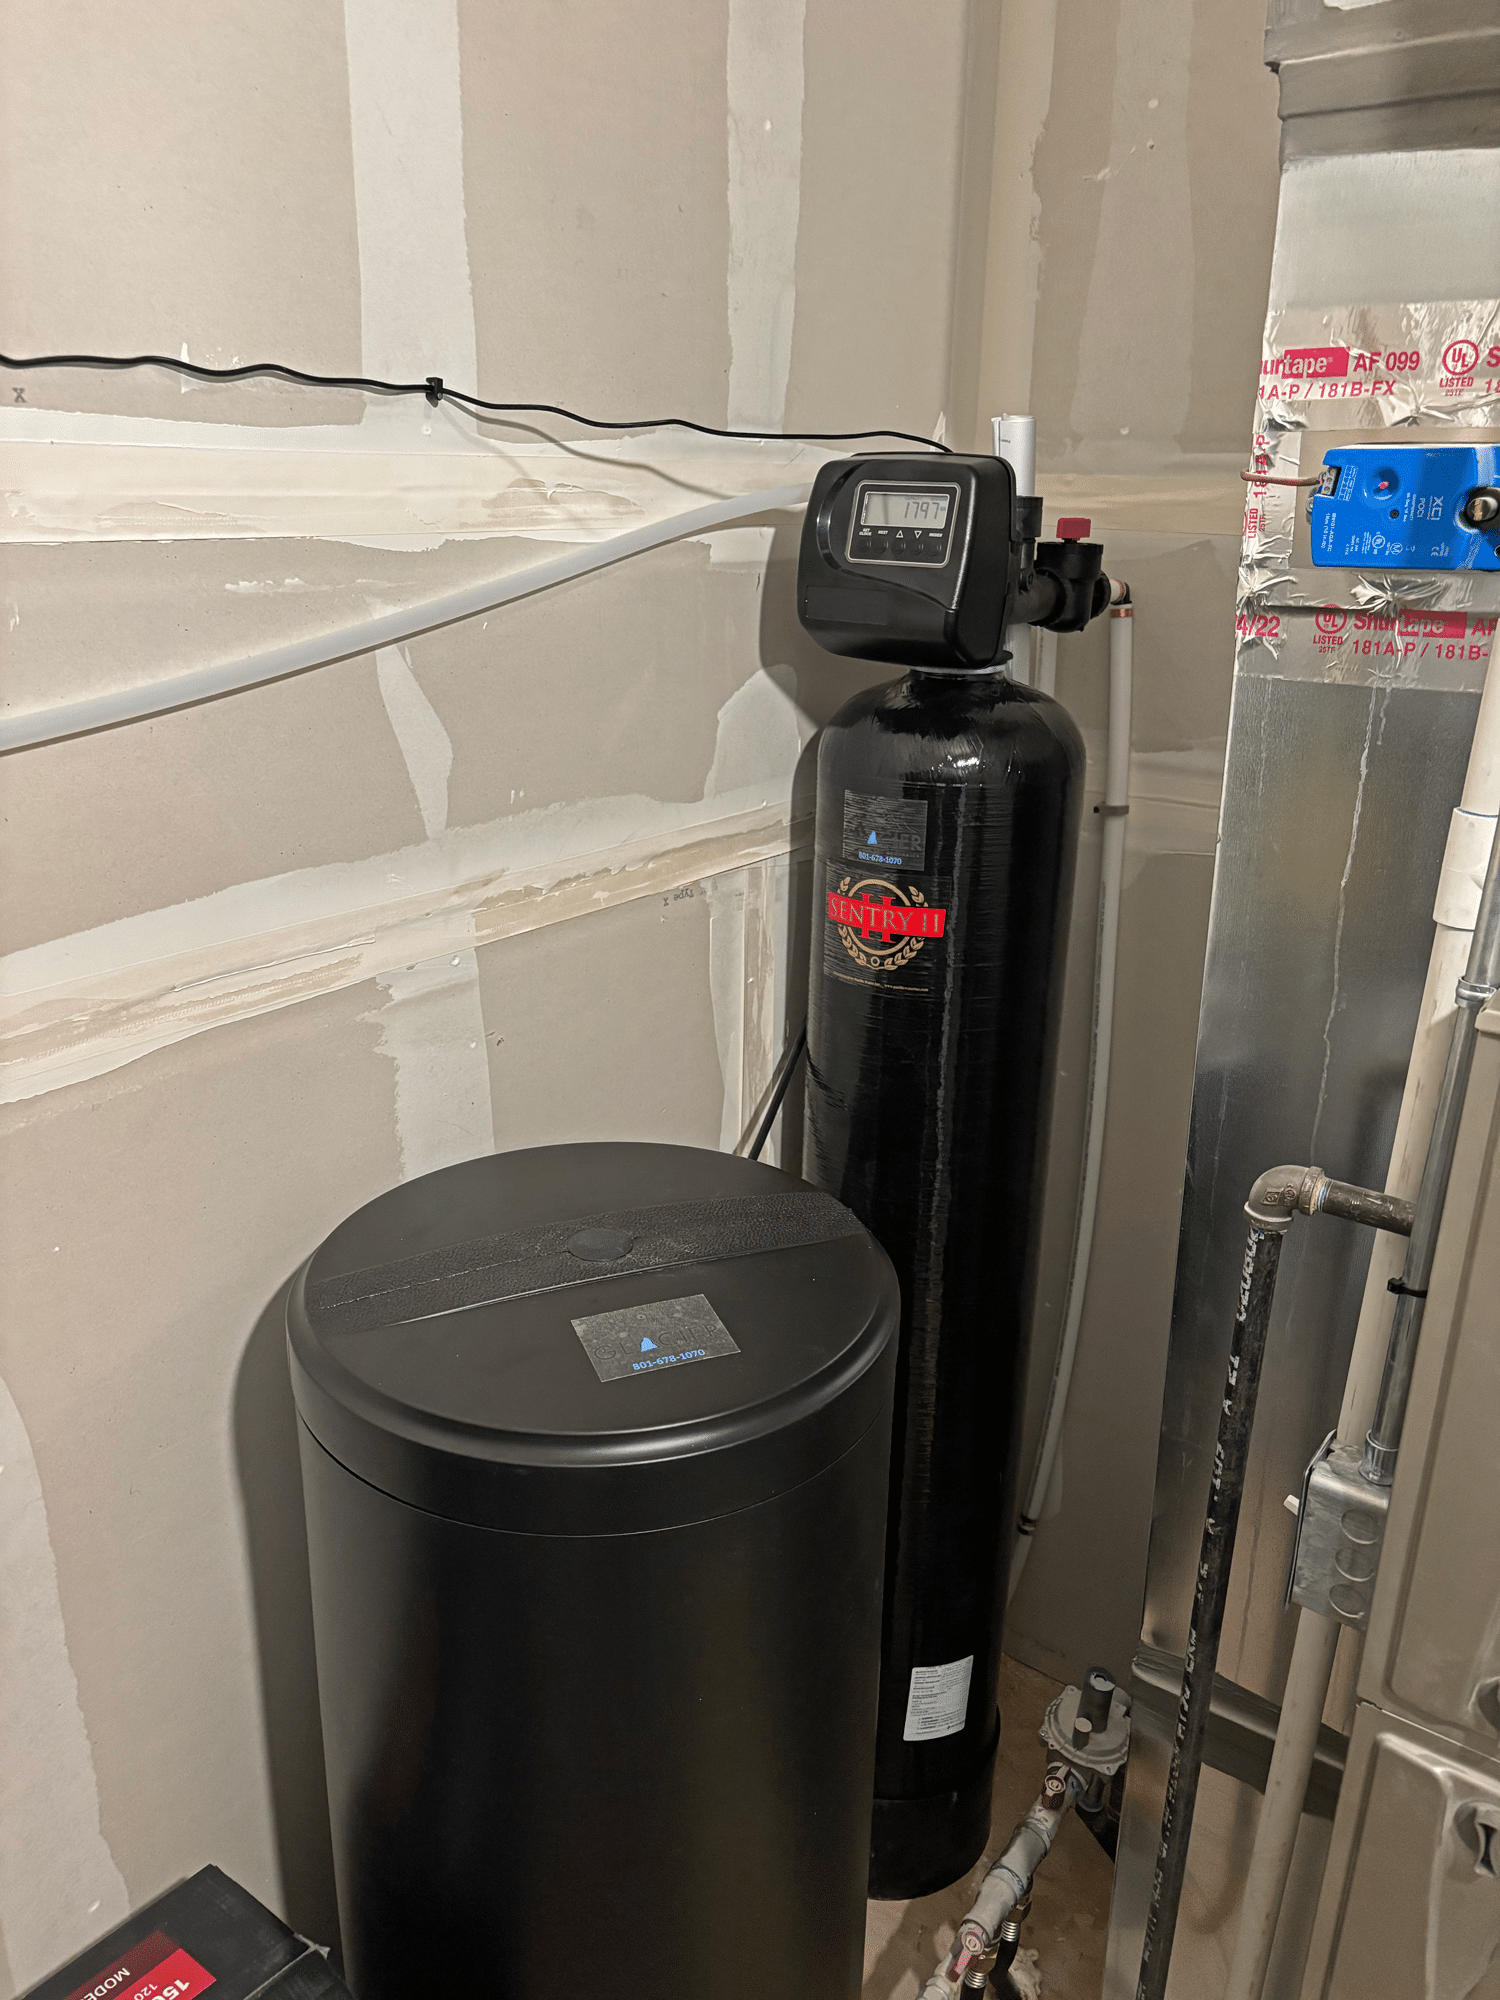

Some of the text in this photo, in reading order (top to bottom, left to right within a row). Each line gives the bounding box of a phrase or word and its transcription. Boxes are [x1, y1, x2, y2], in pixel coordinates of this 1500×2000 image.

[1353, 351, 1382, 372] AF
[1385, 350, 1420, 372] 099
[1318, 379, 1396, 399] 181B-FX
[1439, 376, 1474, 388] LISTED
[904, 501, 940, 520] 1797
[1248, 507, 1258, 539] LISTED
[1312, 634, 1344, 646] LISTED
[1353, 640, 1416, 657] 181A-P
[859, 852, 902, 865] 801-678-1070
[663, 897, 669, 907] X
[673, 888, 695, 901] Type
[831, 897, 939, 933] SENTRY II
[632, 1349, 706, 1371] 801-678-1070
